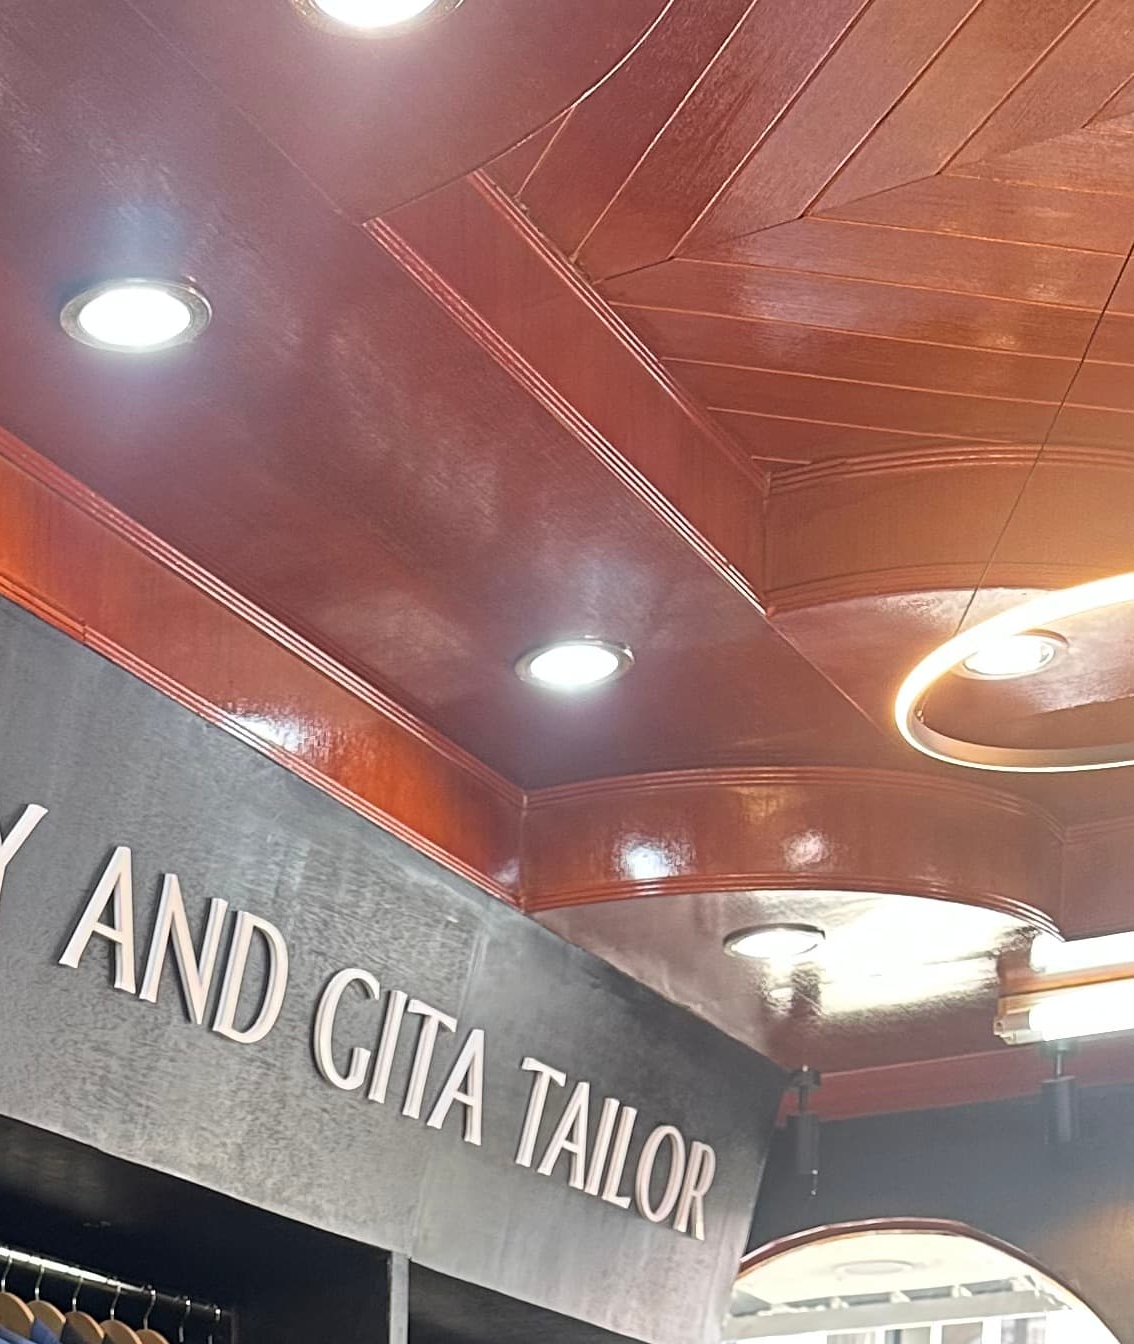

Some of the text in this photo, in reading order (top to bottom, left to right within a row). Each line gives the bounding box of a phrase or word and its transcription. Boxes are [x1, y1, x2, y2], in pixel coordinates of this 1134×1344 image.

[58, 846, 290, 1045] AND
[313, 967, 485, 1147] GITA
[515, 1056, 718, 1241] TAILOR
